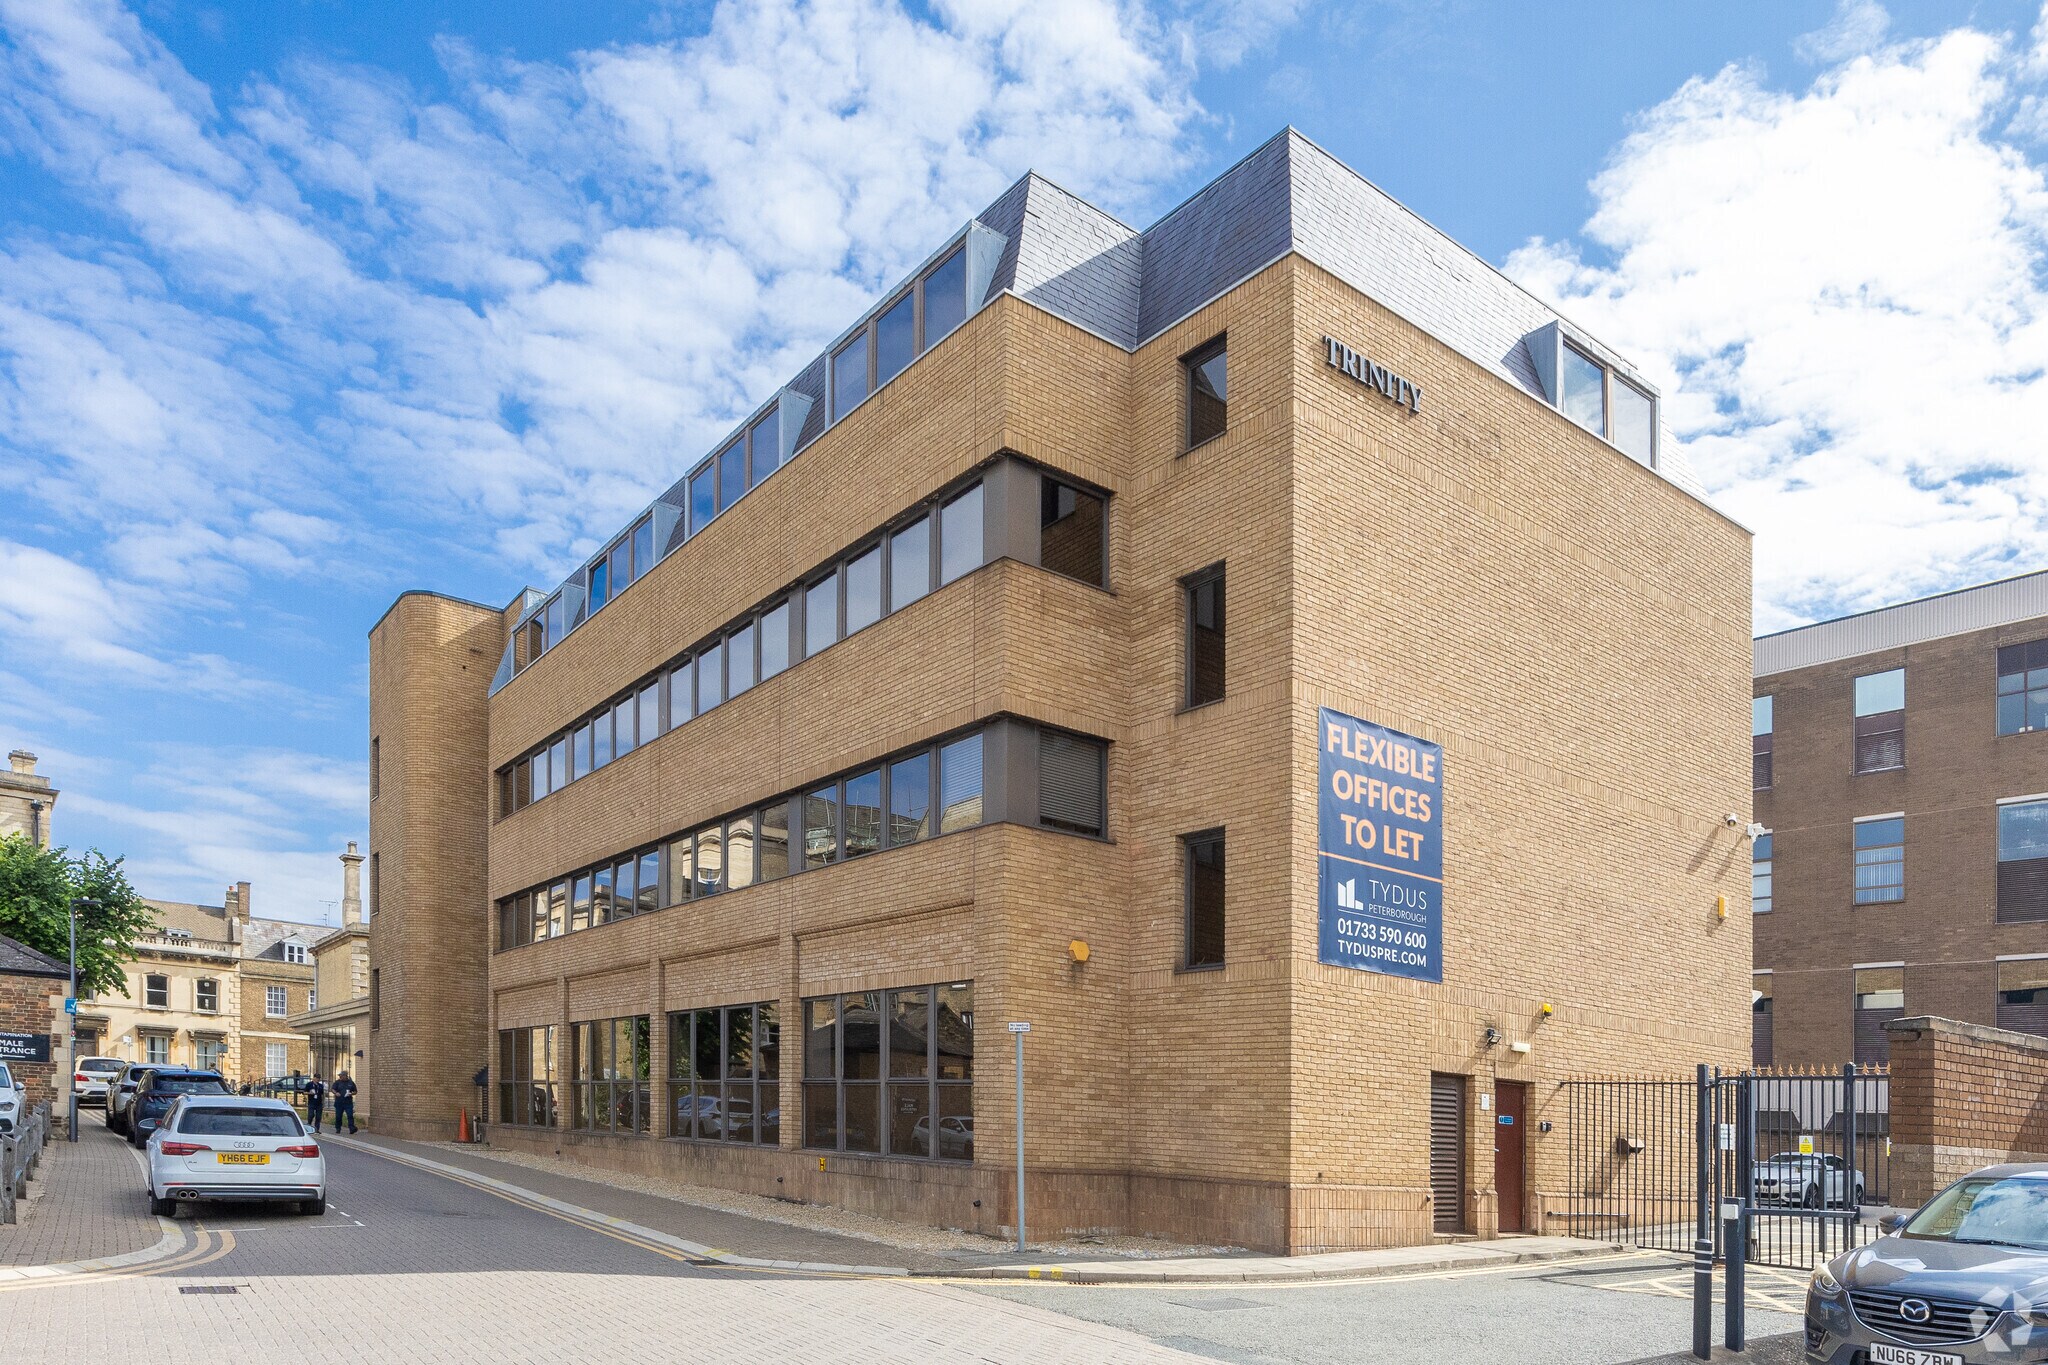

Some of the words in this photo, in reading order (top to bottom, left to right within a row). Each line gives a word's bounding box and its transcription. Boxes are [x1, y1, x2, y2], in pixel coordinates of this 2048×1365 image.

[1324, 335, 1423, 413] TRINITY
[1327, 722, 1435, 783] FLEXIBLE
[1332, 769, 1431, 823] OFFICES
[1340, 814, 1377, 849] TO
[1383, 825, 1424, 861] LET
[1368, 879, 1427, 910] TYDUS
[1368, 903, 1427, 924] PETERBOROUGH
[1337, 917, 1377, 940] 01733
[1379, 925, 1402, 945] 590
[1404, 931, 1427, 949] 600
[1337, 939, 1427, 967] TYDUSPRE.COM
[221, 1154, 246, 1163] YH66
[247, 1155, 266, 1163] EJF
[1876, 1346, 1915, 1365] NU66
